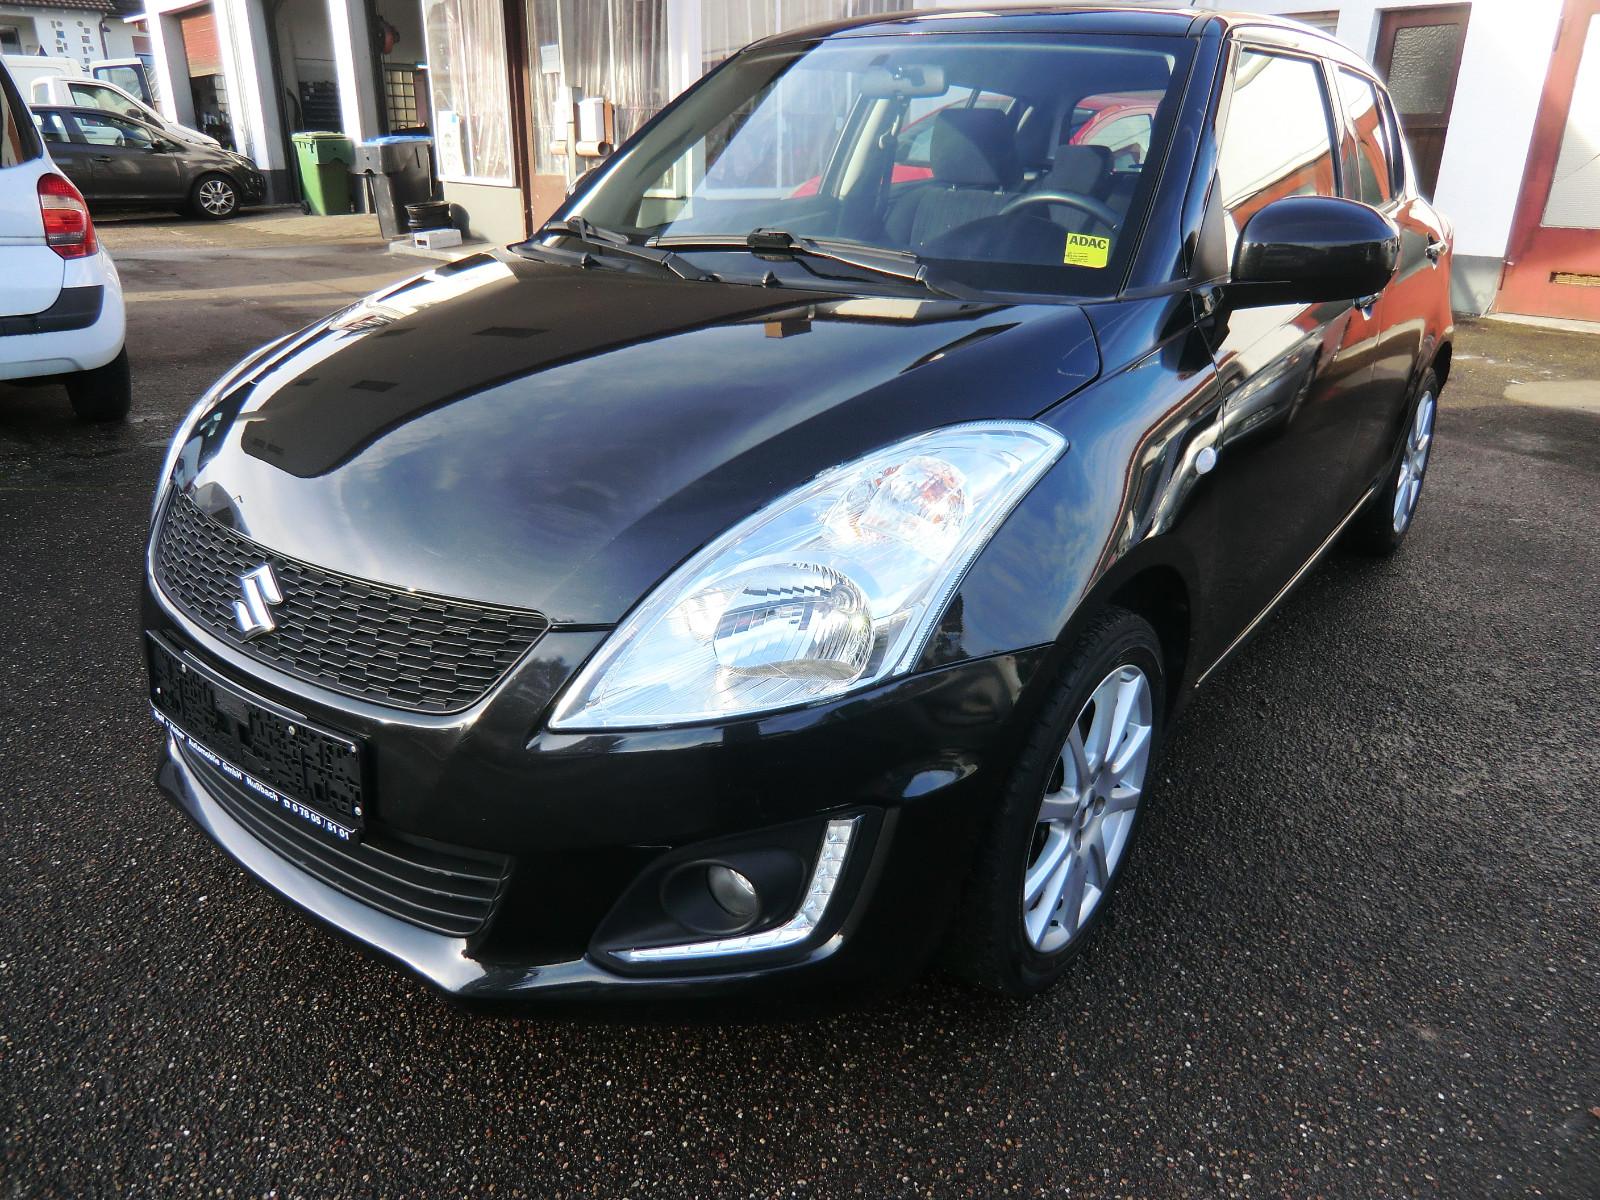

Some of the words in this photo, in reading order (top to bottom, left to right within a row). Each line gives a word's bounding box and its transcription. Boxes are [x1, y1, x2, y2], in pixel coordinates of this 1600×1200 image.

[1069, 235, 1107, 250] ADAC
[222, 761, 242, 780] GmbH
[310, 813, 321, 825] 05
[327, 821, 337, 834] 51
[339, 828, 350, 841] 01
